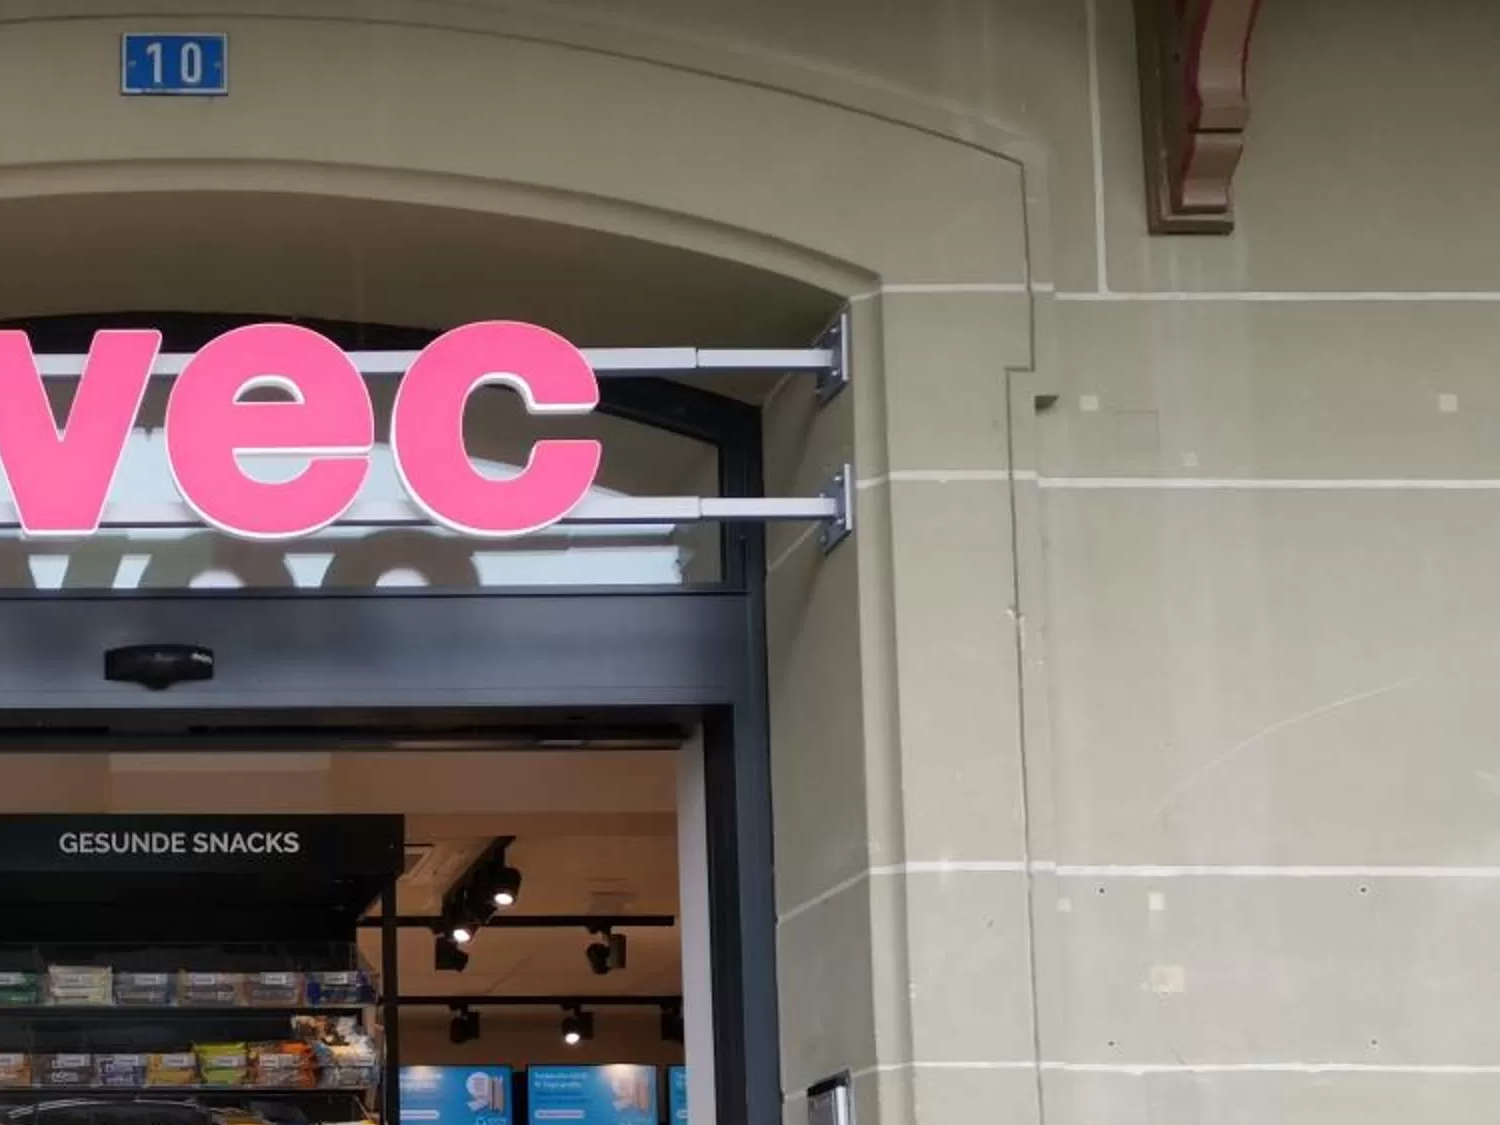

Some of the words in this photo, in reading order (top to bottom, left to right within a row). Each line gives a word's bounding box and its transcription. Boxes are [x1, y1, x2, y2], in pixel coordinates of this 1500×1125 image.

[146, 41, 202, 84] 10
[59, 832, 185, 854] GESUNDE
[192, 832, 300, 854] SNACKS
